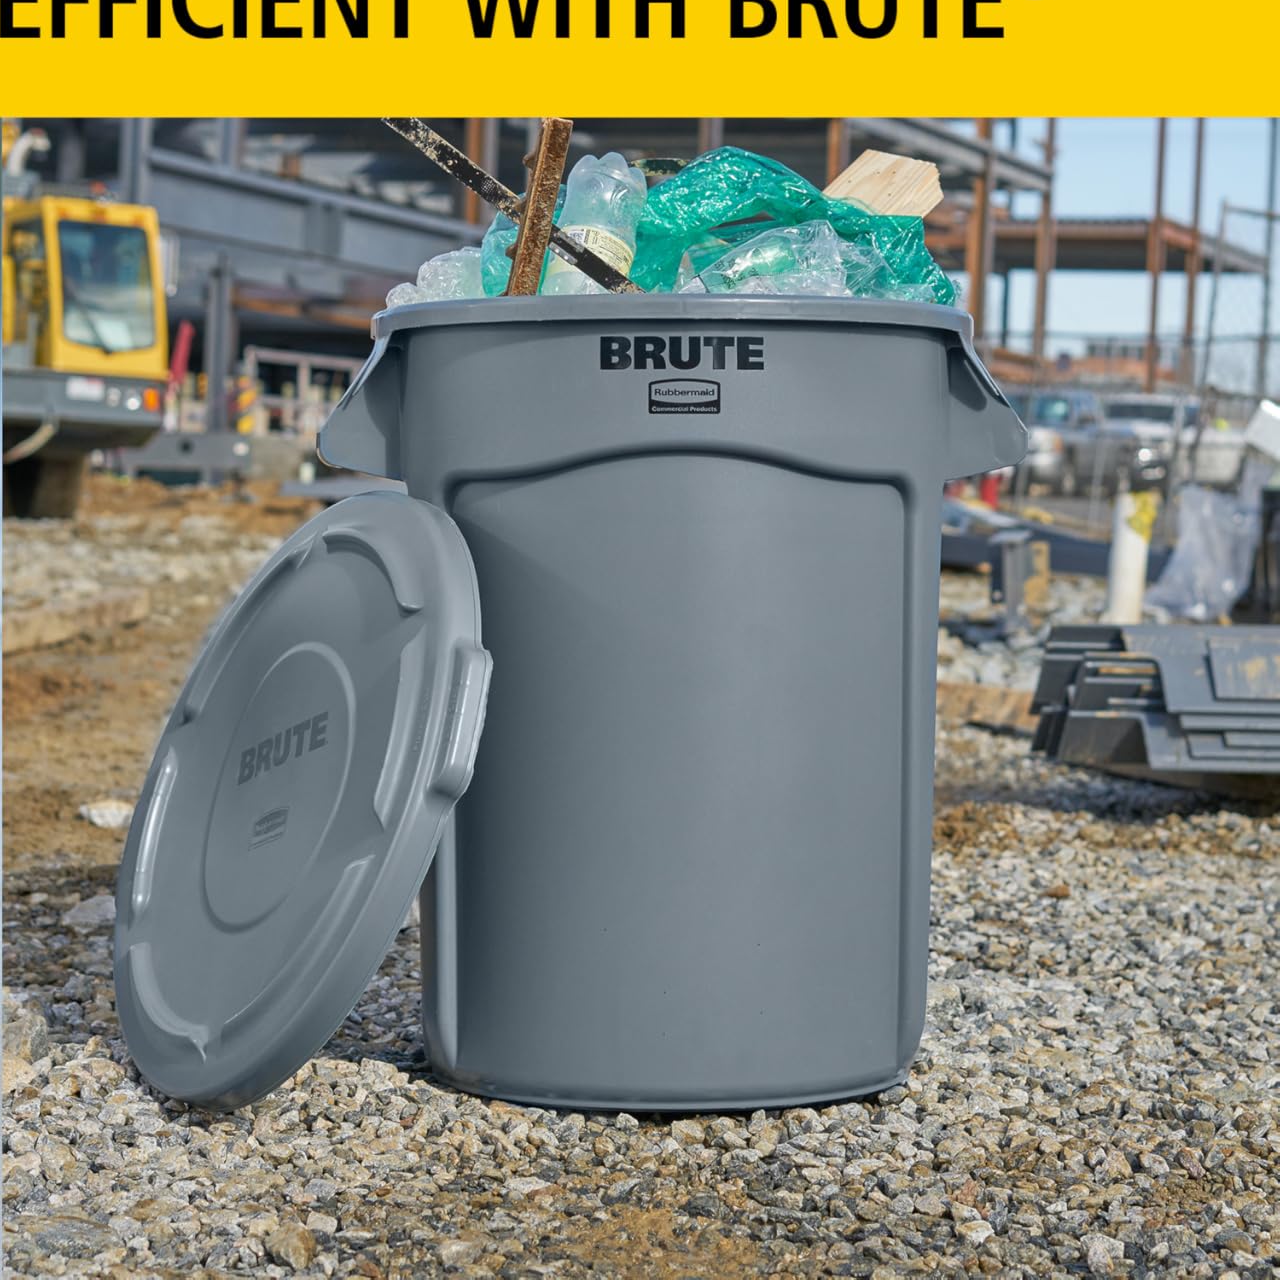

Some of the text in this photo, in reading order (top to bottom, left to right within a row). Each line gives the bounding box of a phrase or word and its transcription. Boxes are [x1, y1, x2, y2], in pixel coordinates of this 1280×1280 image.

[600, 336, 764, 370] BRUTE
[654, 388, 715, 397] Rubbermaid
[237, 711, 329, 786] BRUTE
